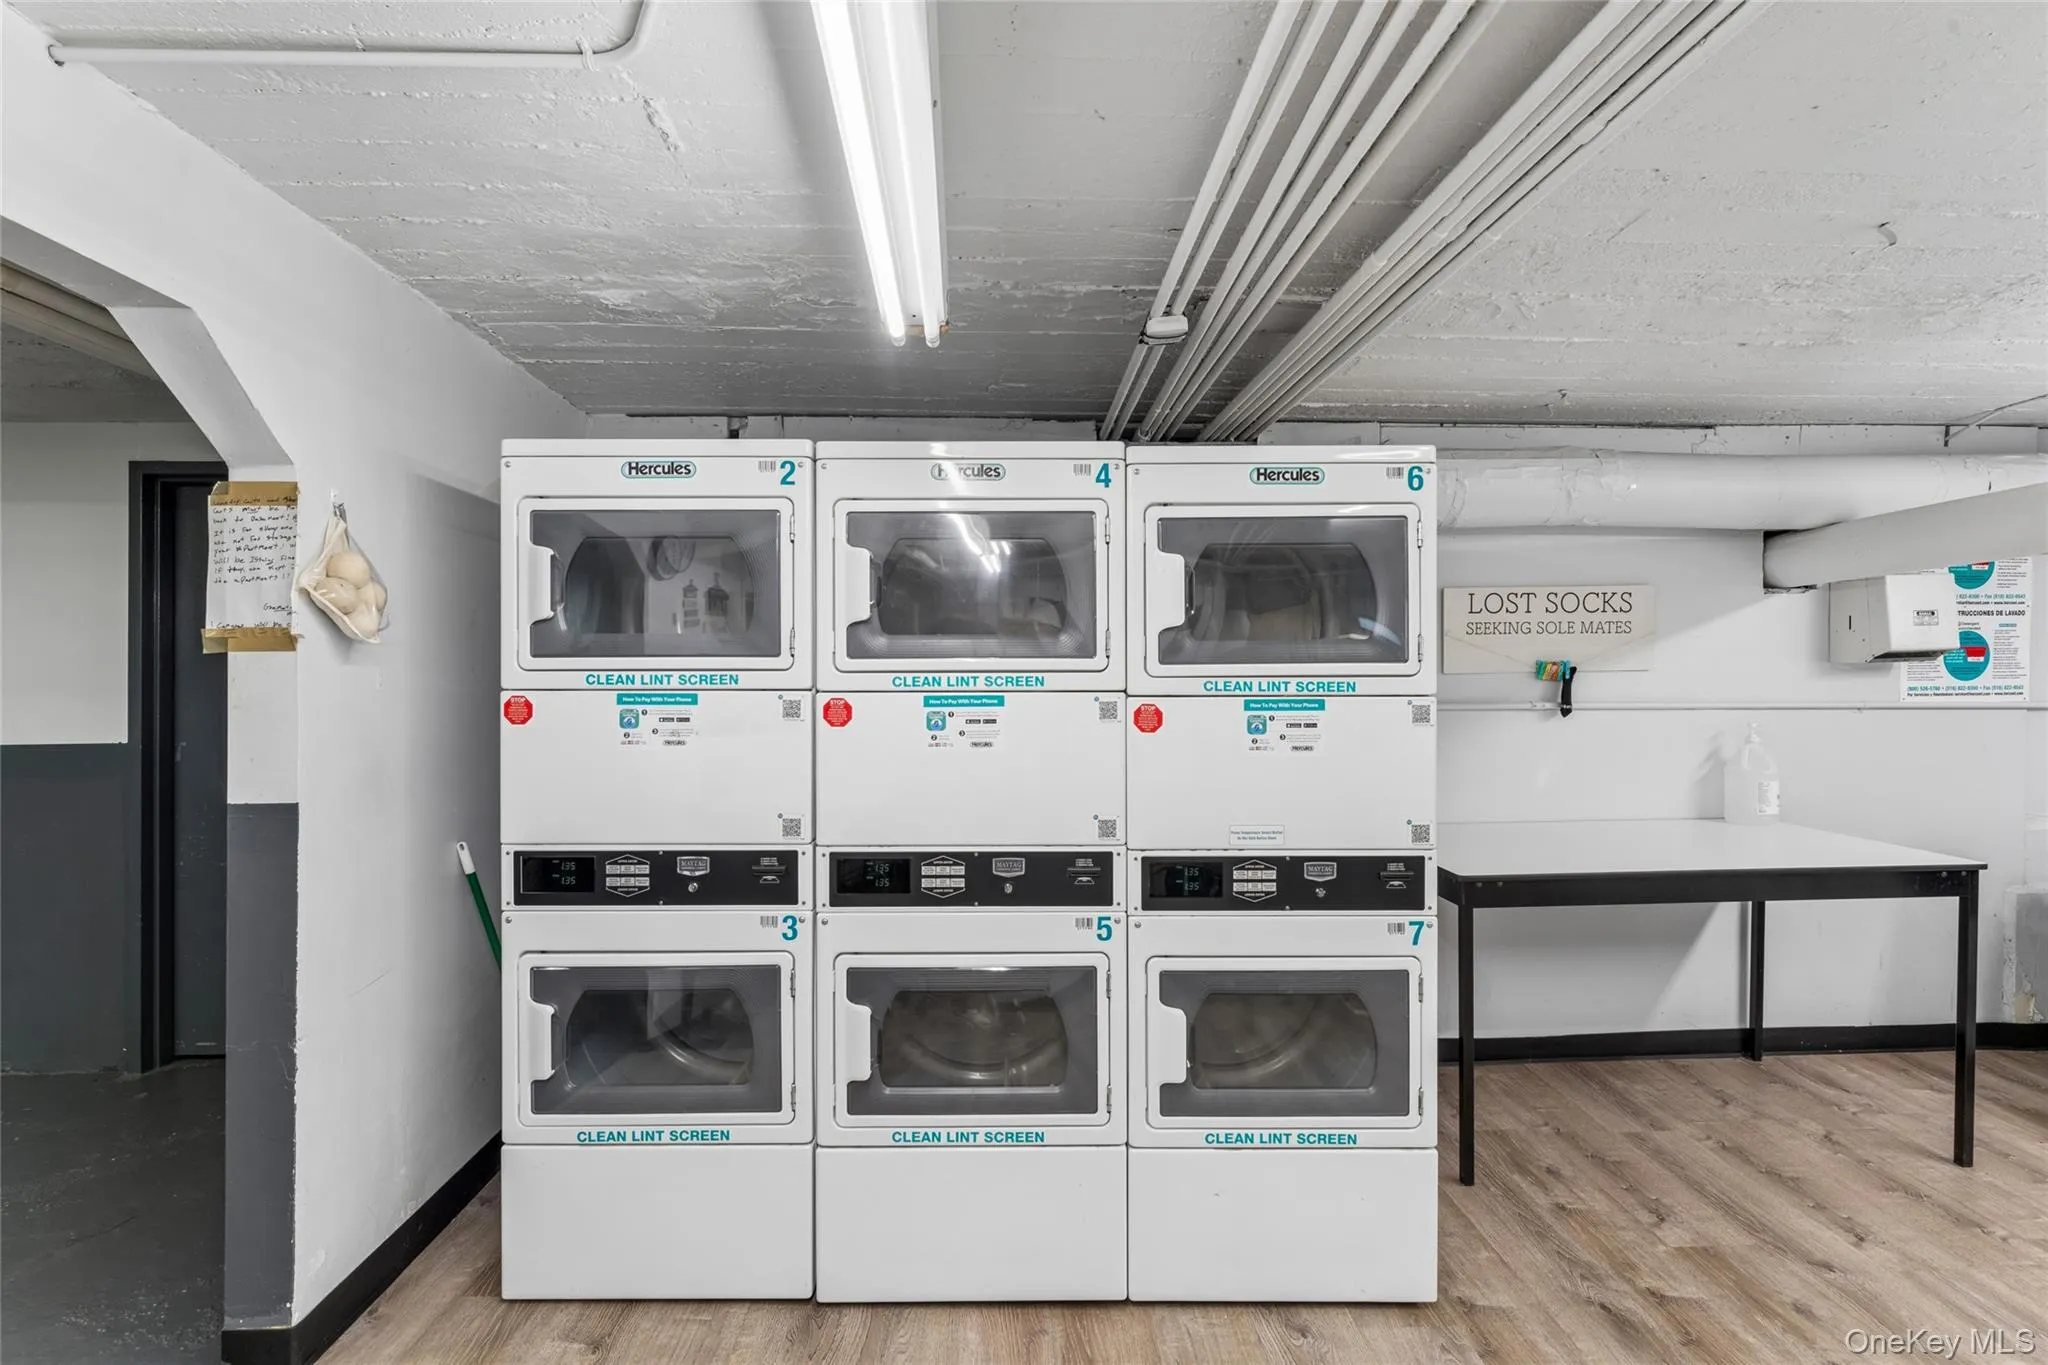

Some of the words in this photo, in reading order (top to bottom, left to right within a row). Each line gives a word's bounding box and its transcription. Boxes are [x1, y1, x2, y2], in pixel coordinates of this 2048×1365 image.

[628, 462, 691, 476] Hercules
[780, 460, 796, 486] 2
[938, 464, 1001, 478] Hrcules
[1095, 463, 1112, 488] 4
[1257, 468, 1320, 482] Hercules
[1408, 465, 1424, 491] 6
[1468, 592, 1537, 614] LOST
[1545, 591, 1633, 613] SOCKS
[1466, 621, 1532, 635] SEEKING
[1536, 620, 1576, 634] SOLE
[1580, 620, 1632, 634] MATES
[585, 674, 635, 686] CLEAN
[640, 674, 673, 686] LINT
[678, 674, 739, 686] SCREEN
[892, 676, 942, 688] CLEAN
[946, 676, 979, 688] LINT
[984, 676, 1045, 688] SCREEN
[1203, 680, 1253, 693] CLEAN
[1258, 680, 1291, 693] LINT
[1295, 680, 1357, 693] SCREEN
[782, 915, 798, 941] 3
[1096, 916, 1113, 942] 5
[1408, 920, 1425, 946] 7
[576, 1130, 627, 1143] CLEAN
[631, 1130, 666, 1143] LINT
[669, 1130, 731, 1143] SCREEN
[892, 1131, 941, 1144] CLEAN
[946, 1131, 980, 1144] LINT
[984, 1131, 1045, 1144] SCREEN
[1204, 1133, 1254, 1145] CLEAN
[1259, 1133, 1292, 1145] LINT
[1297, 1133, 1358, 1145] SCREEN
